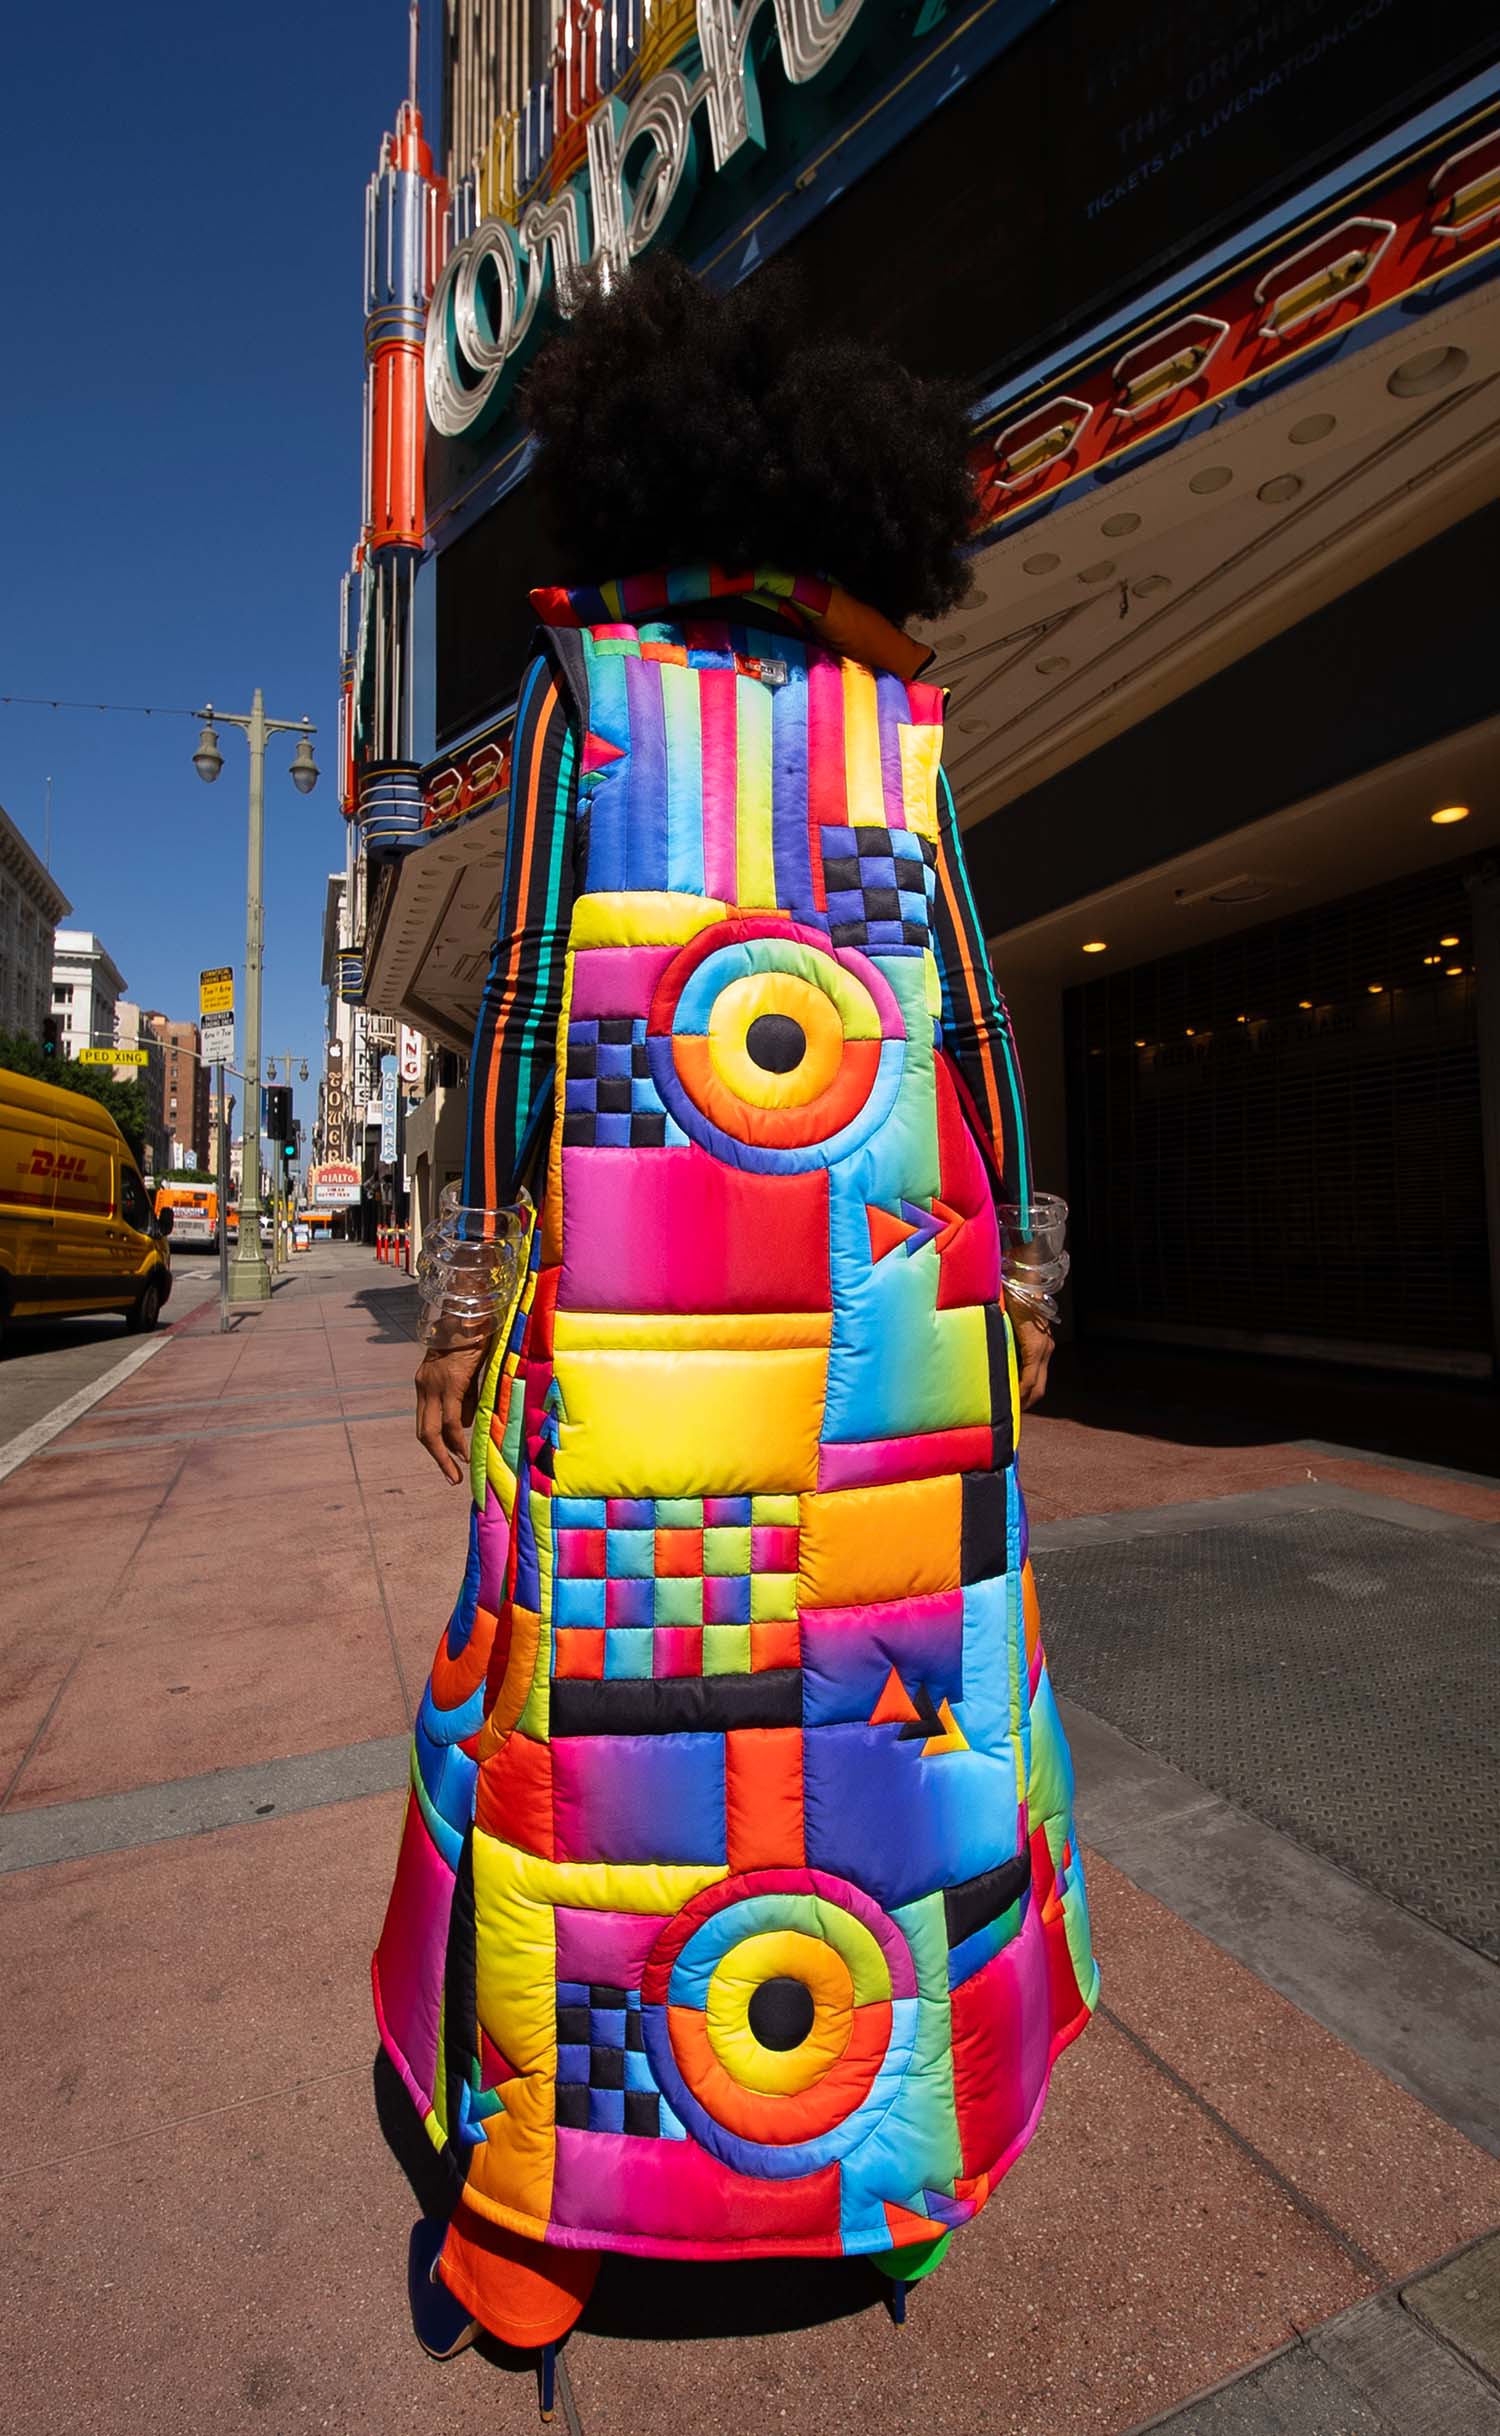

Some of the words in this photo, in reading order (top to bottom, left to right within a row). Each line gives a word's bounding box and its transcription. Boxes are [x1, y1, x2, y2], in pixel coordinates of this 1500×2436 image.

[1085, 151, 1164, 220] TICKETS
[1168, 128, 1196, 161] AT
[1199, 0, 1393, 138] LIVENATION.CO
[1116, 95, 1175, 153] THE
[85, 1051, 110, 1062] PED
[115, 1052, 143, 1064] XING
[385, 1071, 395, 1112] AUTO
[328, 1072, 342, 1163] TOWER
[31, 1149, 89, 1183] DHL
[321, 1173, 354, 1183] RIALTO
